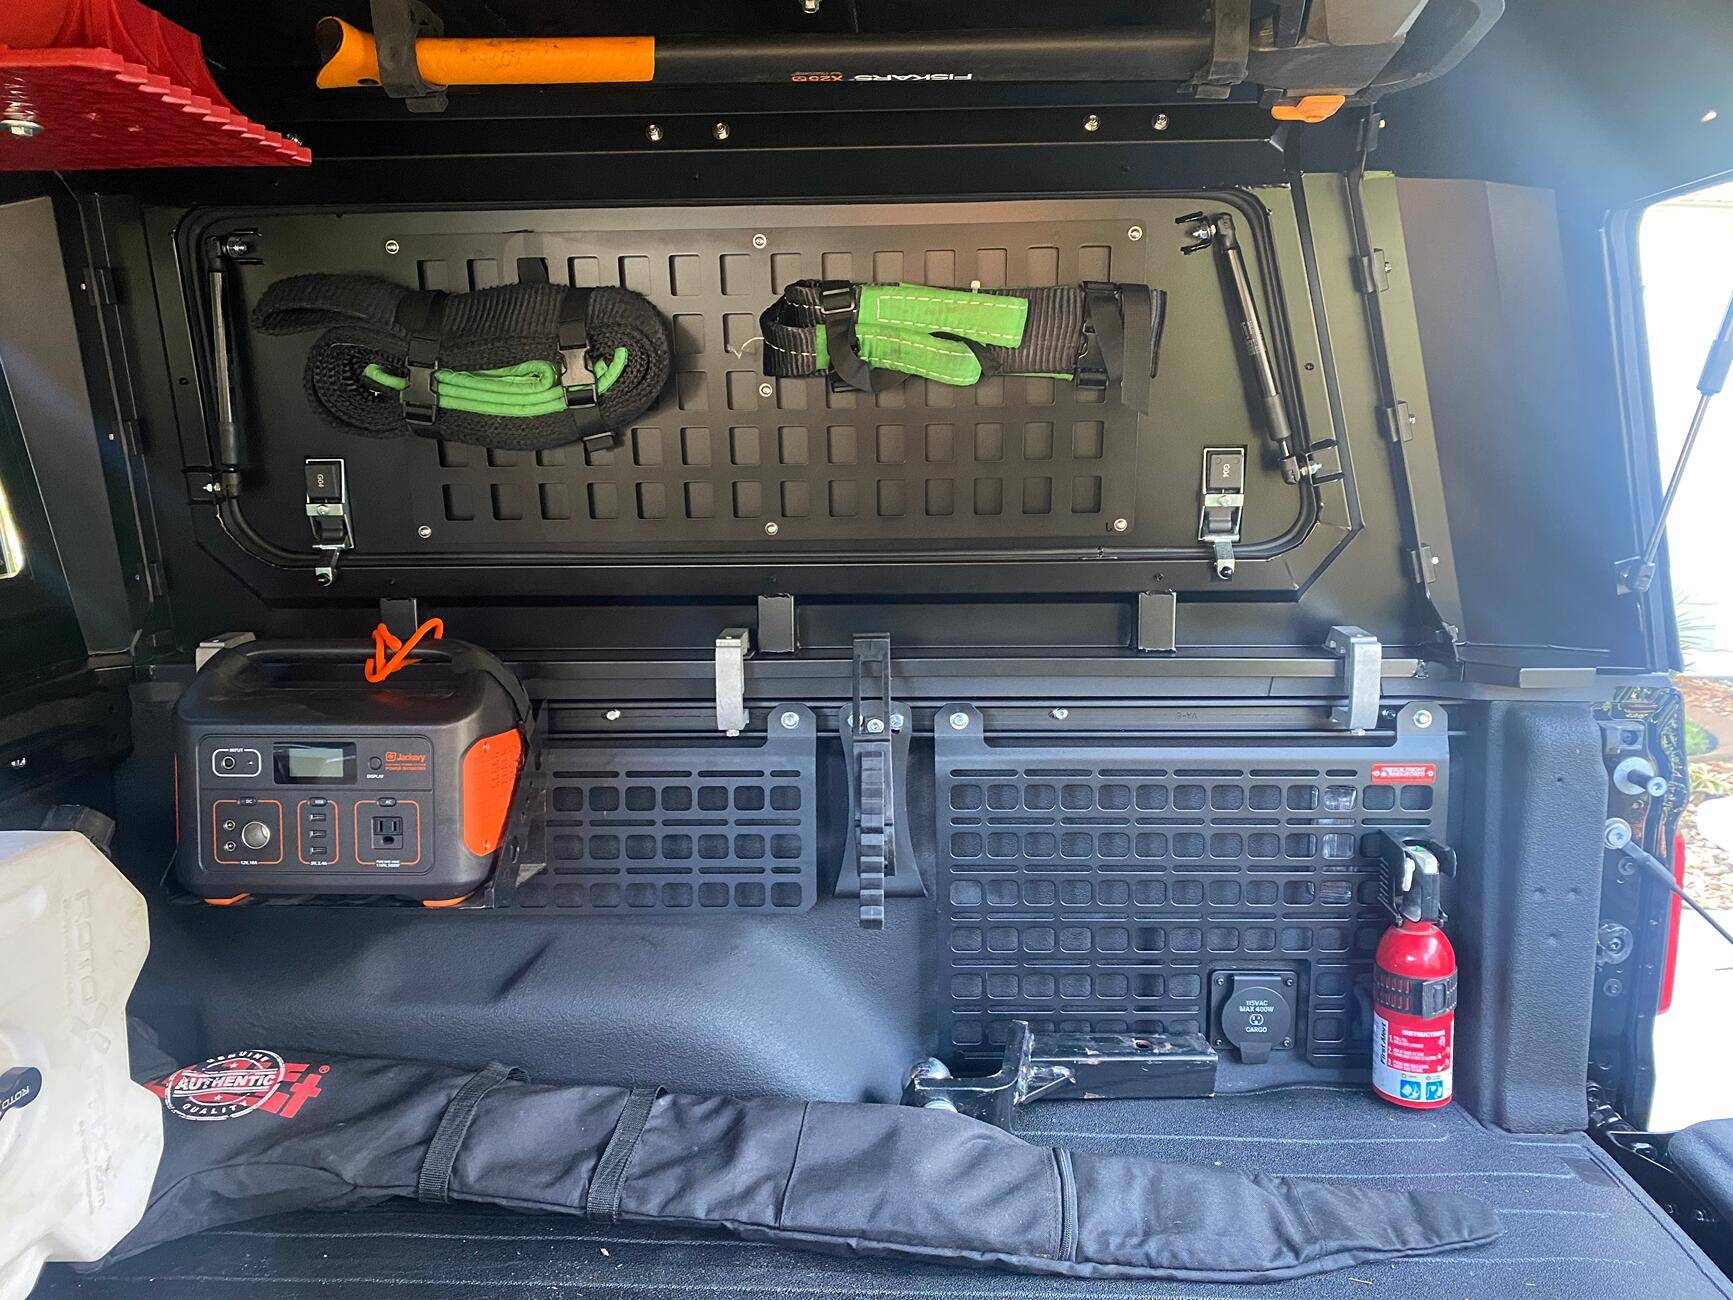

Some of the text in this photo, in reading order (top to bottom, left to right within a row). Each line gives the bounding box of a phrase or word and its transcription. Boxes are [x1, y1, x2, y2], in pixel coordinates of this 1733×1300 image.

[854, 74, 972, 82] FISKARS
[174, 1074, 276, 1091] AUTHENTIC
[1, 1085, 30, 1110] ROTO
[182, 1100, 248, 1115] QUALITY
